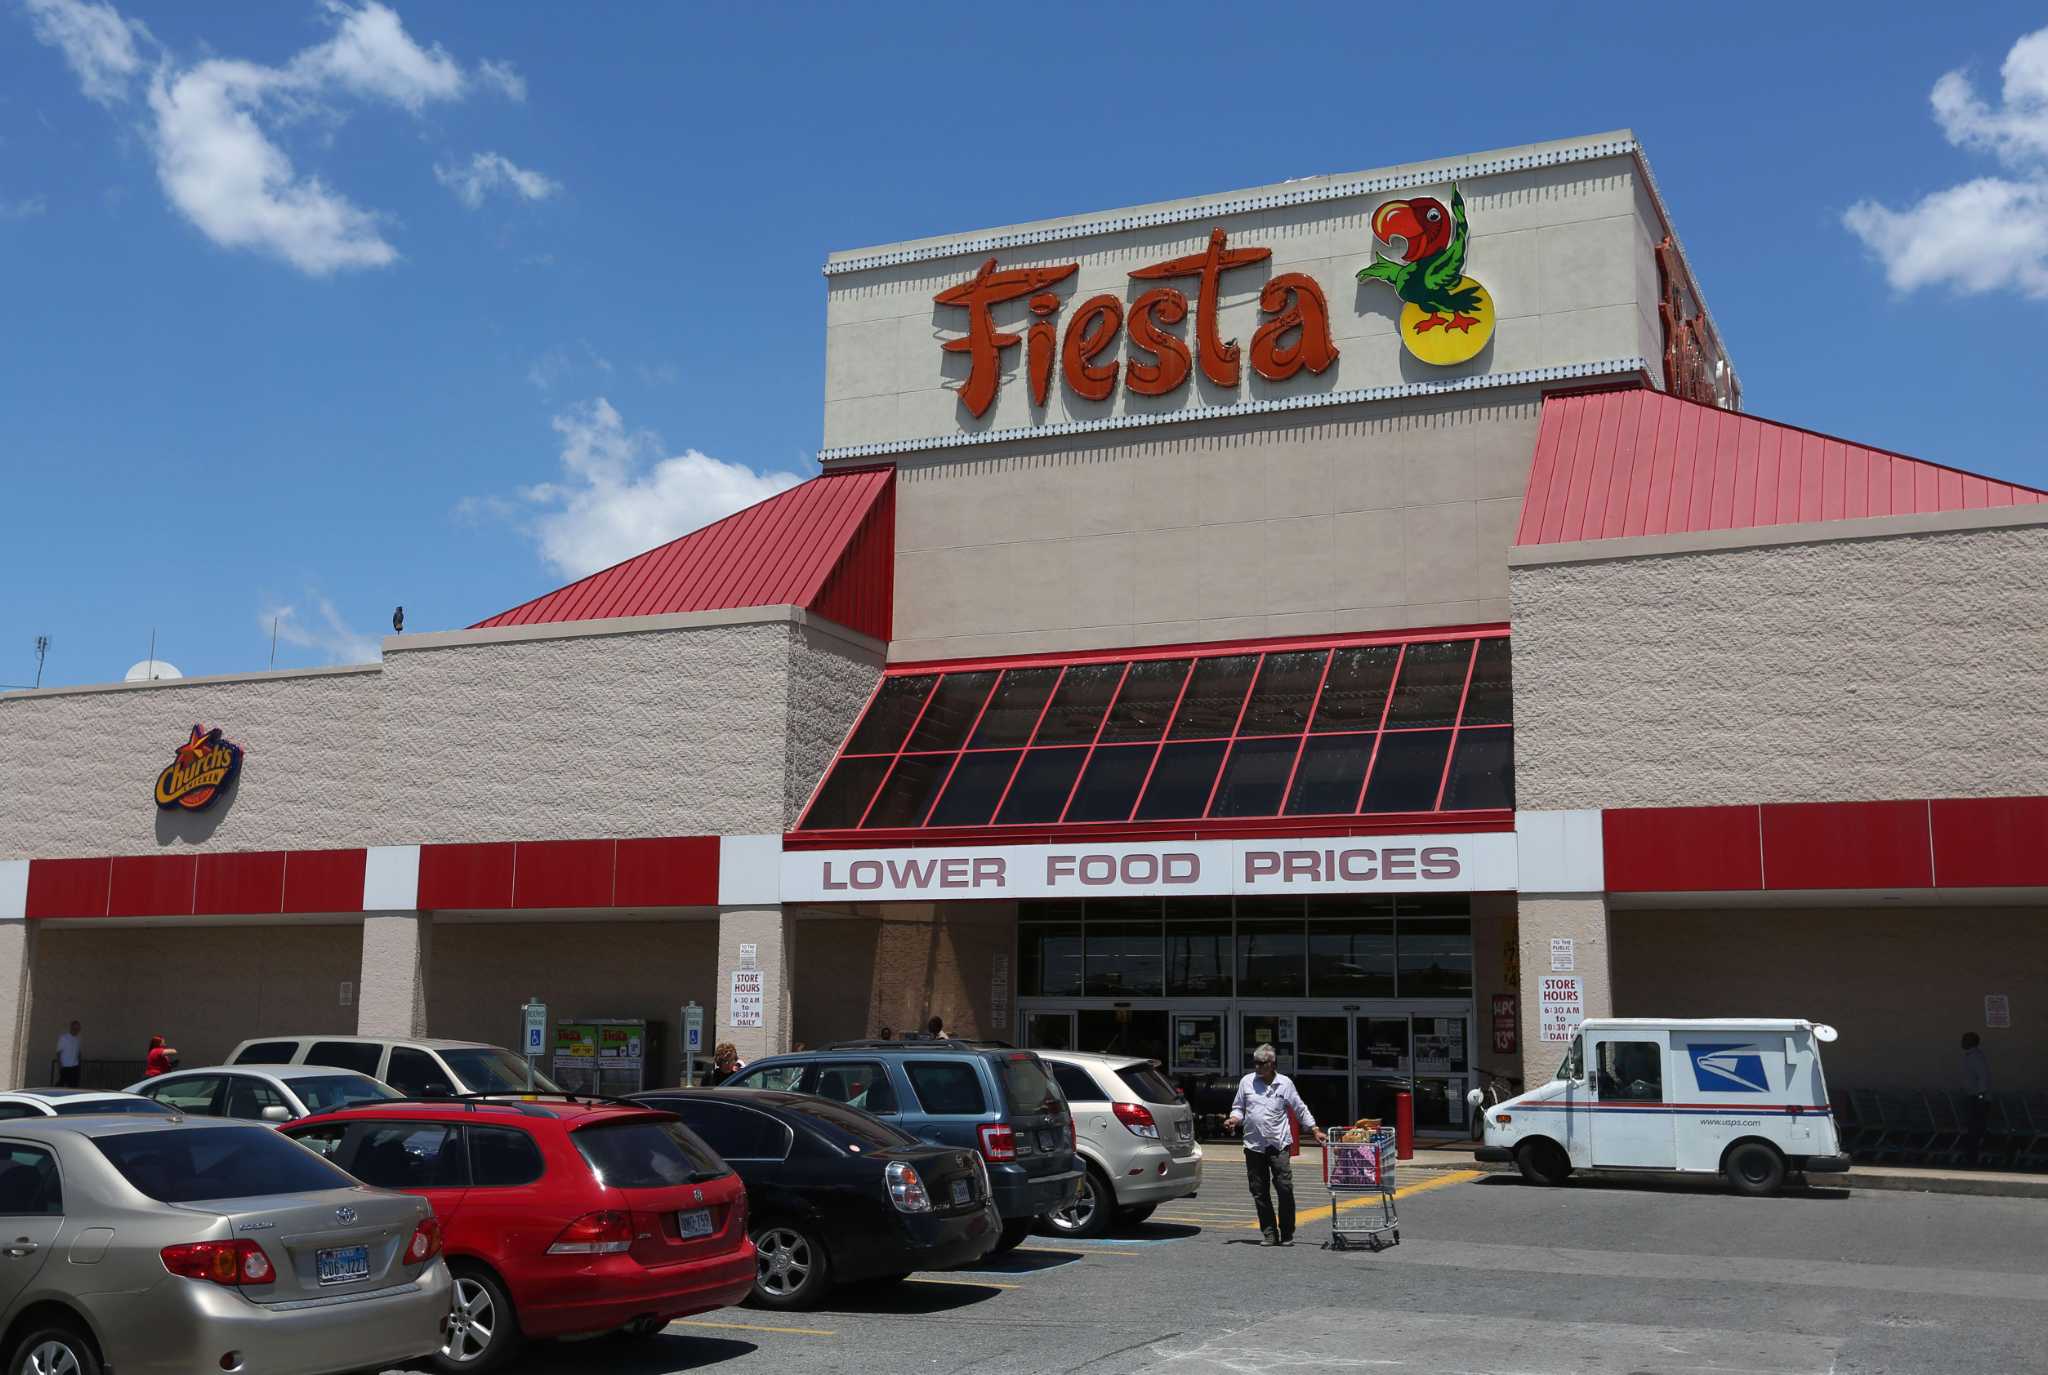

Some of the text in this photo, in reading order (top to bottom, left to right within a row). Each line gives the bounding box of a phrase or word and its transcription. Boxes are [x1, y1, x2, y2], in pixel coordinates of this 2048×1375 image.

[933, 226, 1340, 419] Fiesta
[156, 745, 232, 804] Church's
[822, 847, 1461, 890] LOWER FOOD PRICES
[737, 974, 759, 983] STORE
[735, 984, 760, 992] HOURS
[1545, 980, 1576, 990] STORE
[1544, 991, 1578, 1001] HOURS
[1544, 1006, 1580, 1014] 6:30 AM
[1544, 1023, 1566, 1031] 10:30
[1700, 1119, 1761, 1127] www.usps.com
